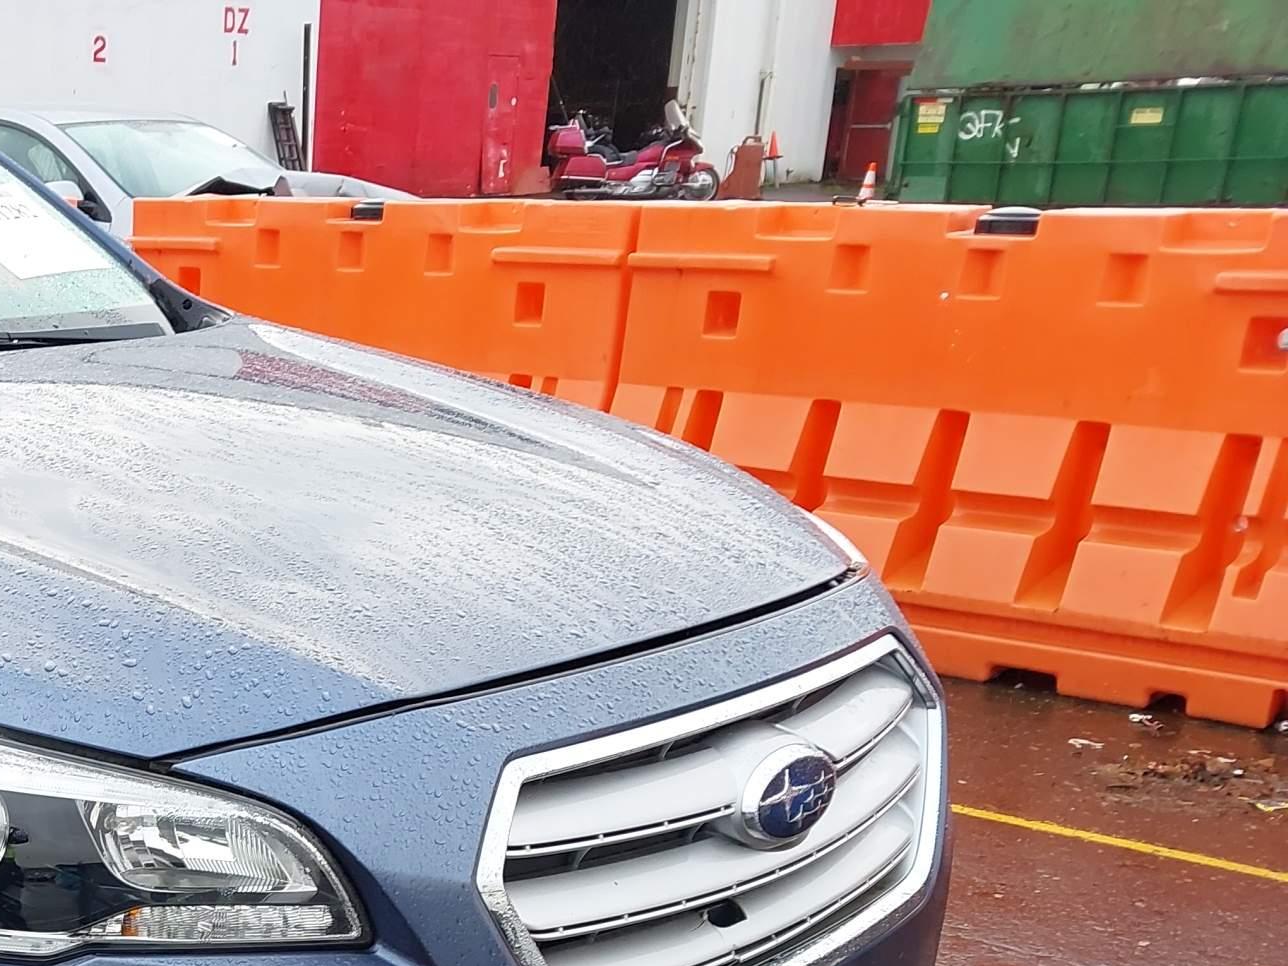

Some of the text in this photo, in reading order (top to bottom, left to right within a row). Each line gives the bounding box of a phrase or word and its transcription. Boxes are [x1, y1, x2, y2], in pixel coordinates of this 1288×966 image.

[224, 7, 250, 34] DZ
[93, 36, 106, 63] 2
[231, 40, 238, 66] 1
